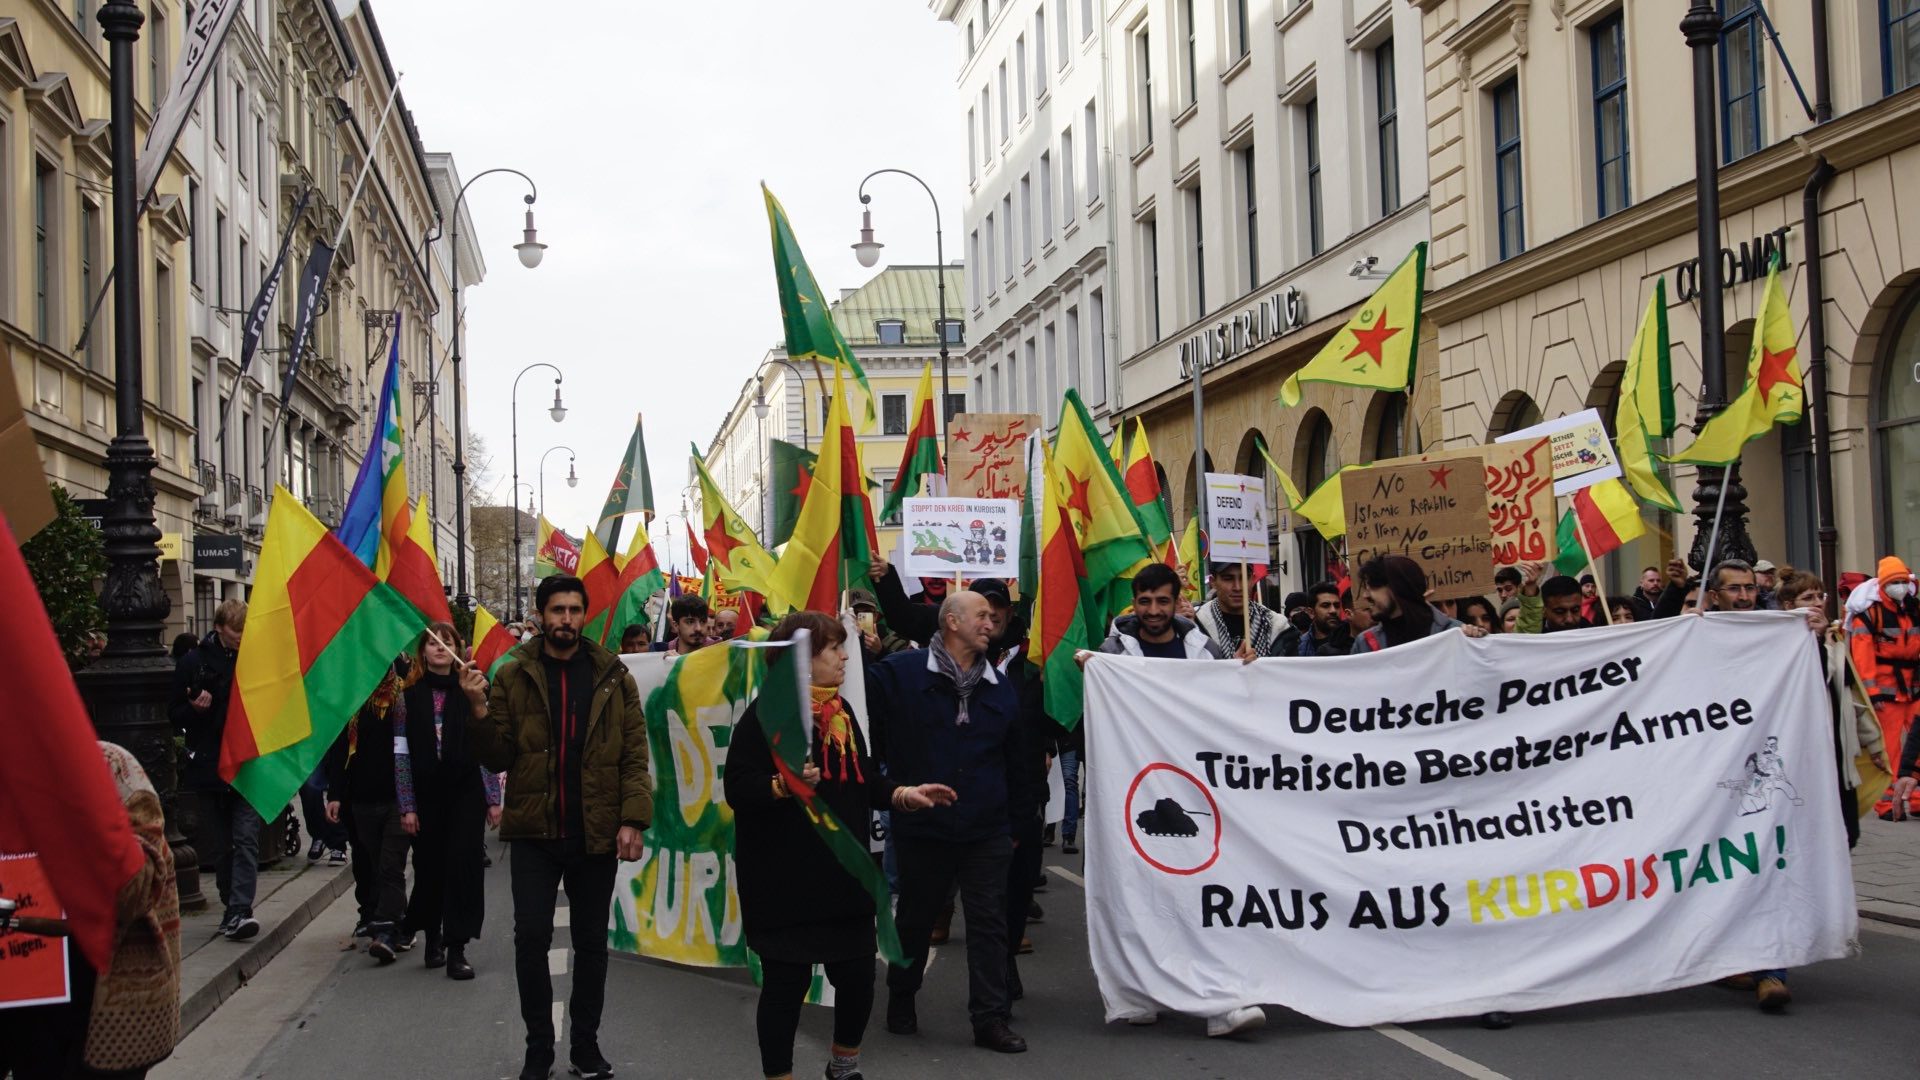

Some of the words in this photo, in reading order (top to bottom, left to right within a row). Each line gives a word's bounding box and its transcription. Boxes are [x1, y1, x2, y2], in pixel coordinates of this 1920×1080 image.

[1677, 225, 1791, 302] COO-MAT
[1178, 285, 1304, 379] KUNSTRING
[911, 504, 933, 513] STOPPT
[934, 504, 947, 512] DEN
[947, 504, 965, 512] KRIEG
[974, 505, 1006, 514] KURDISTAN
[1216, 496, 1242, 509] DEFEND
[1217, 517, 1253, 531] KURDISTAN
[1357, 528, 1369, 541] of
[1375, 520, 1400, 541] Iran
[197, 549, 230, 557] LUMAS
[1290, 690, 1485, 734] Deutsche
[1497, 657, 1642, 714] Panzer
[1195, 752, 1406, 791] Türkische
[1415, 699, 1754, 784] Besatzer-Armee
[1338, 796, 1633, 853] Dschihadisten
[1202, 885, 1330, 930] RAUS
[1349, 883, 1450, 930] AUS
[1468, 832, 1760, 923] KURDISTAN
[8, 937, 48, 958] lügen.
